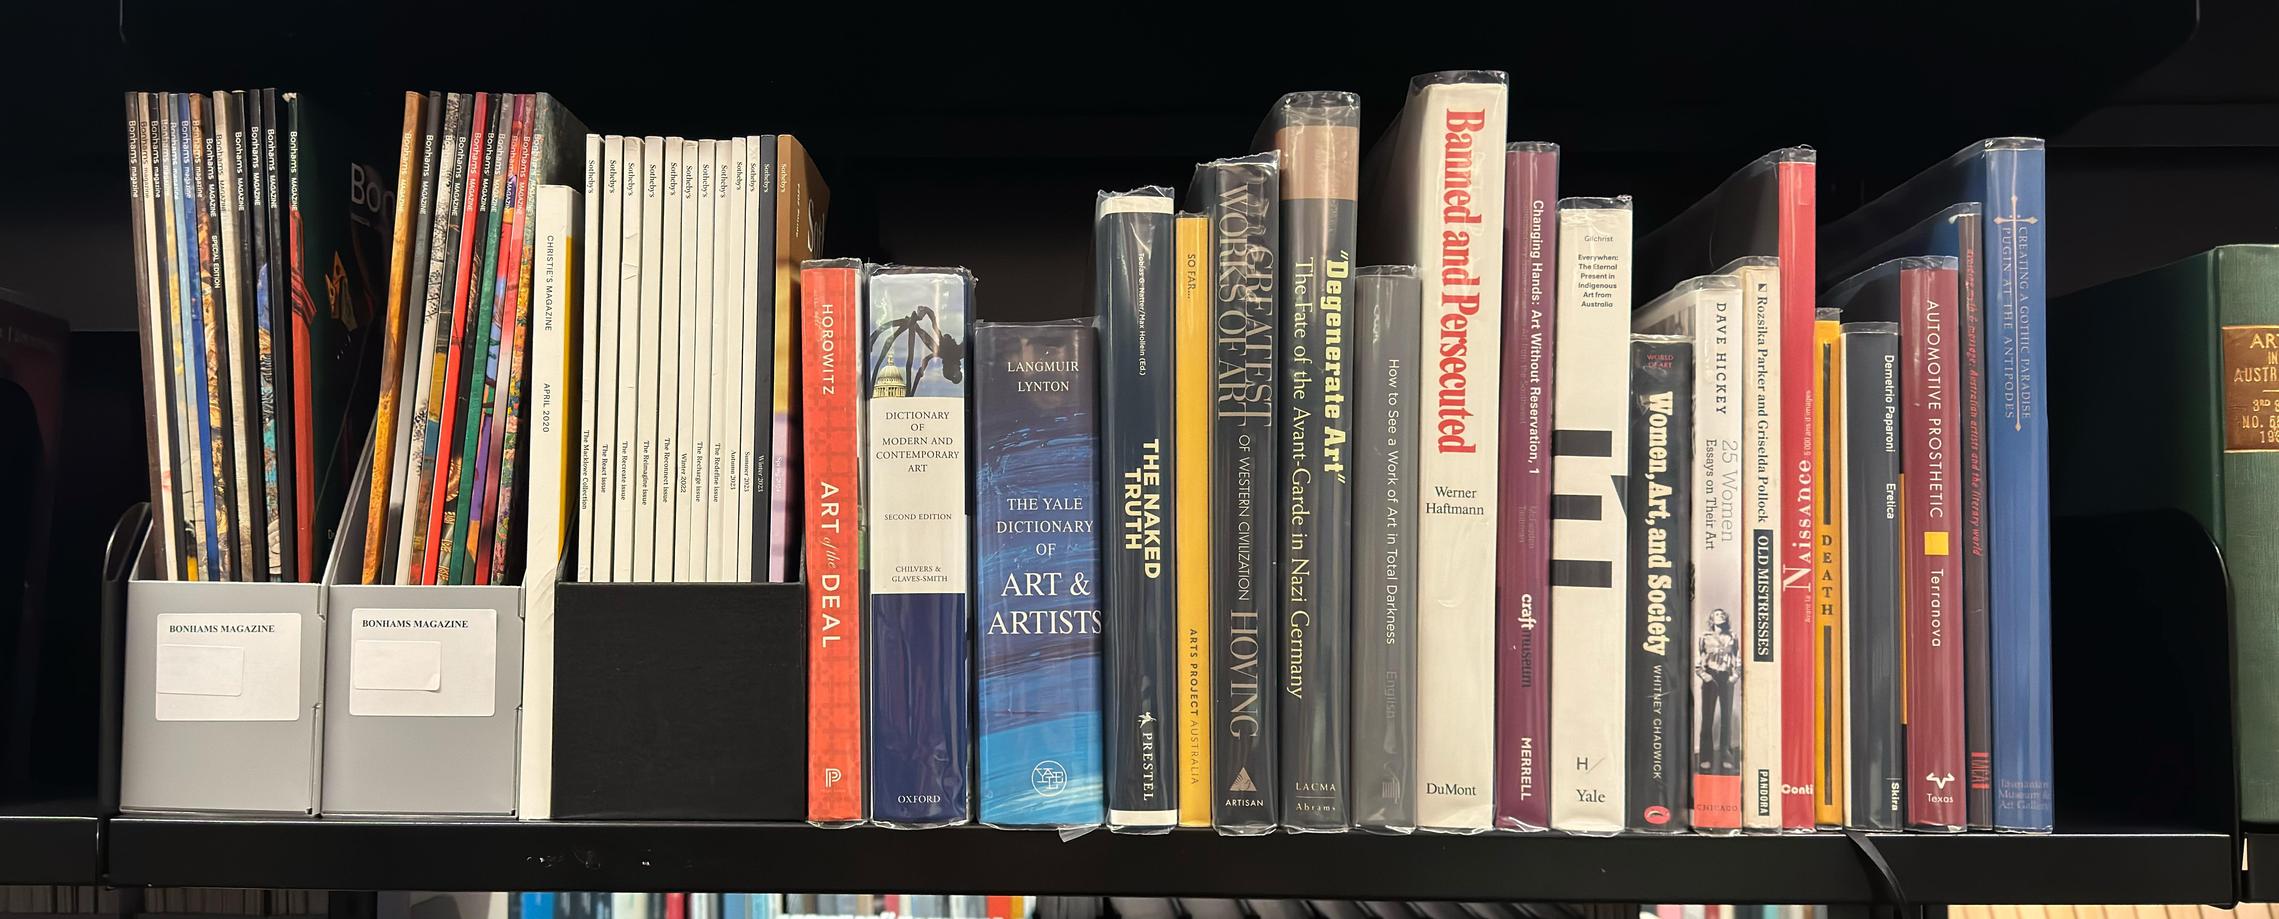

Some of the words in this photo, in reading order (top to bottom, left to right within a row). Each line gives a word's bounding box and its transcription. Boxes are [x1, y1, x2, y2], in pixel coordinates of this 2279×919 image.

[128, 120, 138, 164] Bonhams
[205, 138, 215, 180] Bonhams
[290, 131, 298, 173] Bonhams
[455, 136, 466, 178] Bonhams
[131, 166, 139, 198] magazine
[587, 160, 595, 194] Sotheby's
[649, 164, 657, 198] Sotheby's
[1443, 108, 1486, 224] Banned
[209, 184, 217, 217] MAGAZINE
[290, 178, 298, 211] MAGAZINE
[452, 183, 460, 216] MAGAZINE
[1219, 183, 1248, 302] WORKS
[1530, 200, 1544, 258] Changing
[211, 235, 219, 262] SPECIAL
[545, 235, 554, 283] CHRISTIE'S
[1441, 231, 1481, 286] and
[2002, 227, 2012, 272] PUGIN
[2018, 226, 2029, 289] CREATING
[1294, 257, 1315, 295] The
[1531, 263, 1543, 305] Hands:
[1578, 282, 1617, 290] Indigenous
[2003, 279, 2013, 295] AT
[544, 285, 553, 331] MAGAZINE
[2020, 293, 2029, 301] A
[1219, 310, 1247, 355] OF
[1294, 302, 1314, 338] Fate
[1320, 250, 1349, 419] "Degenerate
[1531, 309, 1543, 329] Art
[1716, 303, 1726, 345] DAVE
[1757, 297, 1768, 345] Rozsika
[2003, 304, 2013, 329] THE
[2020, 306, 2030, 353] GOTHIC
[822, 303, 835, 396] HOROWITZ
[1246, 247, 1275, 426] GREATEST
[1293, 345, 1313, 364] of
[1007, 361, 1079, 373] LANGMUIR
[1437, 292, 1480, 454] Persecuted
[1530, 333, 1542, 383] Without
[1757, 349, 1768, 392] Parker
[1926, 300, 1941, 410] AUTOMOTIVE
[1018, 381, 1070, 392] LYNTON
[1293, 371, 1313, 400] the
[1388, 359, 1400, 389] How
[1716, 353, 1727, 415] HICKEY
[1884, 355, 1895, 403] Demetrio
[2004, 336, 2014, 419] ANTIPODES
[2021, 359, 2031, 419] PARADISE
[542, 383, 551, 408] APRIL
[1219, 361, 1247, 426] ART
[1388, 392, 1399, 406] to
[1758, 394, 1769, 417] and
[542, 410, 550, 433] 2020
[886, 411, 950, 421] DICTIONARY
[911, 423, 925, 432] OF
[1388, 410, 1399, 434] See
[1528, 387, 1542, 464] Reservation,
[1883, 406, 1896, 452] Paparoni
[2242, 416, 2263, 429] NO.
[882, 437, 929, 445] MODERN
[931, 436, 954, 445] AND
[1239, 435, 1250, 451] OF
[1388, 438, 1396, 446] a
[1645, 391, 1673, 480] Women,
[1721, 439, 1738, 463] 25
[1757, 420, 1769, 473] Griselda
[876, 450, 960, 459] CONTEMPORARY
[908, 464, 928, 473] ART
[1143, 438, 1160, 484] THE
[1292, 407, 1312, 525] Avant-Garde
[1325, 426, 1346, 484] Art"
[1387, 450, 1399, 486] Work
[1530, 467, 1540, 475] 1
[1704, 439, 1717, 476] Essays
[1928, 418, 1943, 518] PROSTHETIC
[1007, 498, 1038, 510] THE
[1042, 498, 1083, 510] YALE
[1239, 458, 1250, 517] WESTERN
[1387, 489, 1399, 503] of
[1435, 486, 1477, 498] Werner
[1645, 481, 1673, 526] Art,
[1706, 480, 1714, 494] on
[1757, 476, 1769, 522] Pollock
[1886, 483, 1896, 519] Eretica
[821, 481, 839, 533] ART
[884, 513, 917, 521] SECOND
[918, 512, 952, 520] EDITION
[1125, 468, 1142, 549] TRUTH
[1387, 507, 1399, 528] Art
[1425, 502, 1485, 515] Haftmann
[1705, 497, 1716, 529] Their
[1721, 471, 1738, 542] Women
[821, 537, 838, 549] of
[996, 520, 1094, 533] DICTIONARY
[1144, 493, 1161, 579] NAKED
[1291, 533, 1310, 550] in
[1387, 533, 1398, 545] in
[1706, 531, 1716, 550] Art
[826, 550, 841, 568] the
[1036, 543, 1056, 556] OF
[1239, 521, 1251, 600] CIVILIZATION
[1386, 549, 1399, 581] Total
[1648, 528, 1672, 569] and
[1757, 536, 1769, 565] OLD
[1001, 572, 1062, 597] ART
[1070, 572, 1091, 597] &
[1291, 558, 1310, 602] Nazi
[362, 619, 411, 628] BONHAMS
[413, 619, 469, 629] MAGAZINE
[822, 574, 841, 649] DEAL
[987, 610, 1101, 635] ARTISTS
[1386, 585, 1399, 645] Darkness
[1643, 574, 1672, 656] Society
[1757, 568, 1770, 656] MISTRESSES
[1931, 568, 1943, 647] Terranova
[169, 624, 218, 633] BONHAMS
[220, 624, 275, 633] MAGAZINE
[1190, 629, 1199, 658] ARTS
[1287, 610, 1310, 700] Germany
[1190, 663, 1199, 717] PROJECT
[1230, 609, 1260, 741] HOVING
[1652, 664, 1662, 714] WHITNEY
[1384, 671, 1397, 719] English
[1142, 732, 1155, 801] PRESTEL
[1190, 720, 1200, 785] AUSTRALIA
[1653, 718, 1663, 780] CHADWICK
[1296, 783, 1336, 792] LACMA
[1521, 738, 1532, 801] MERRELL
[898, 795, 941, 803] OXFORD
[1226, 799, 1264, 807] ARTISAN
[1426, 783, 1476, 796] DuMont
[1576, 789, 1606, 802] Yale
[1759, 771, 1769, 815] PANDORA
[1891, 782, 1899, 811] Skira
[1926, 793, 1954, 803] Texas
